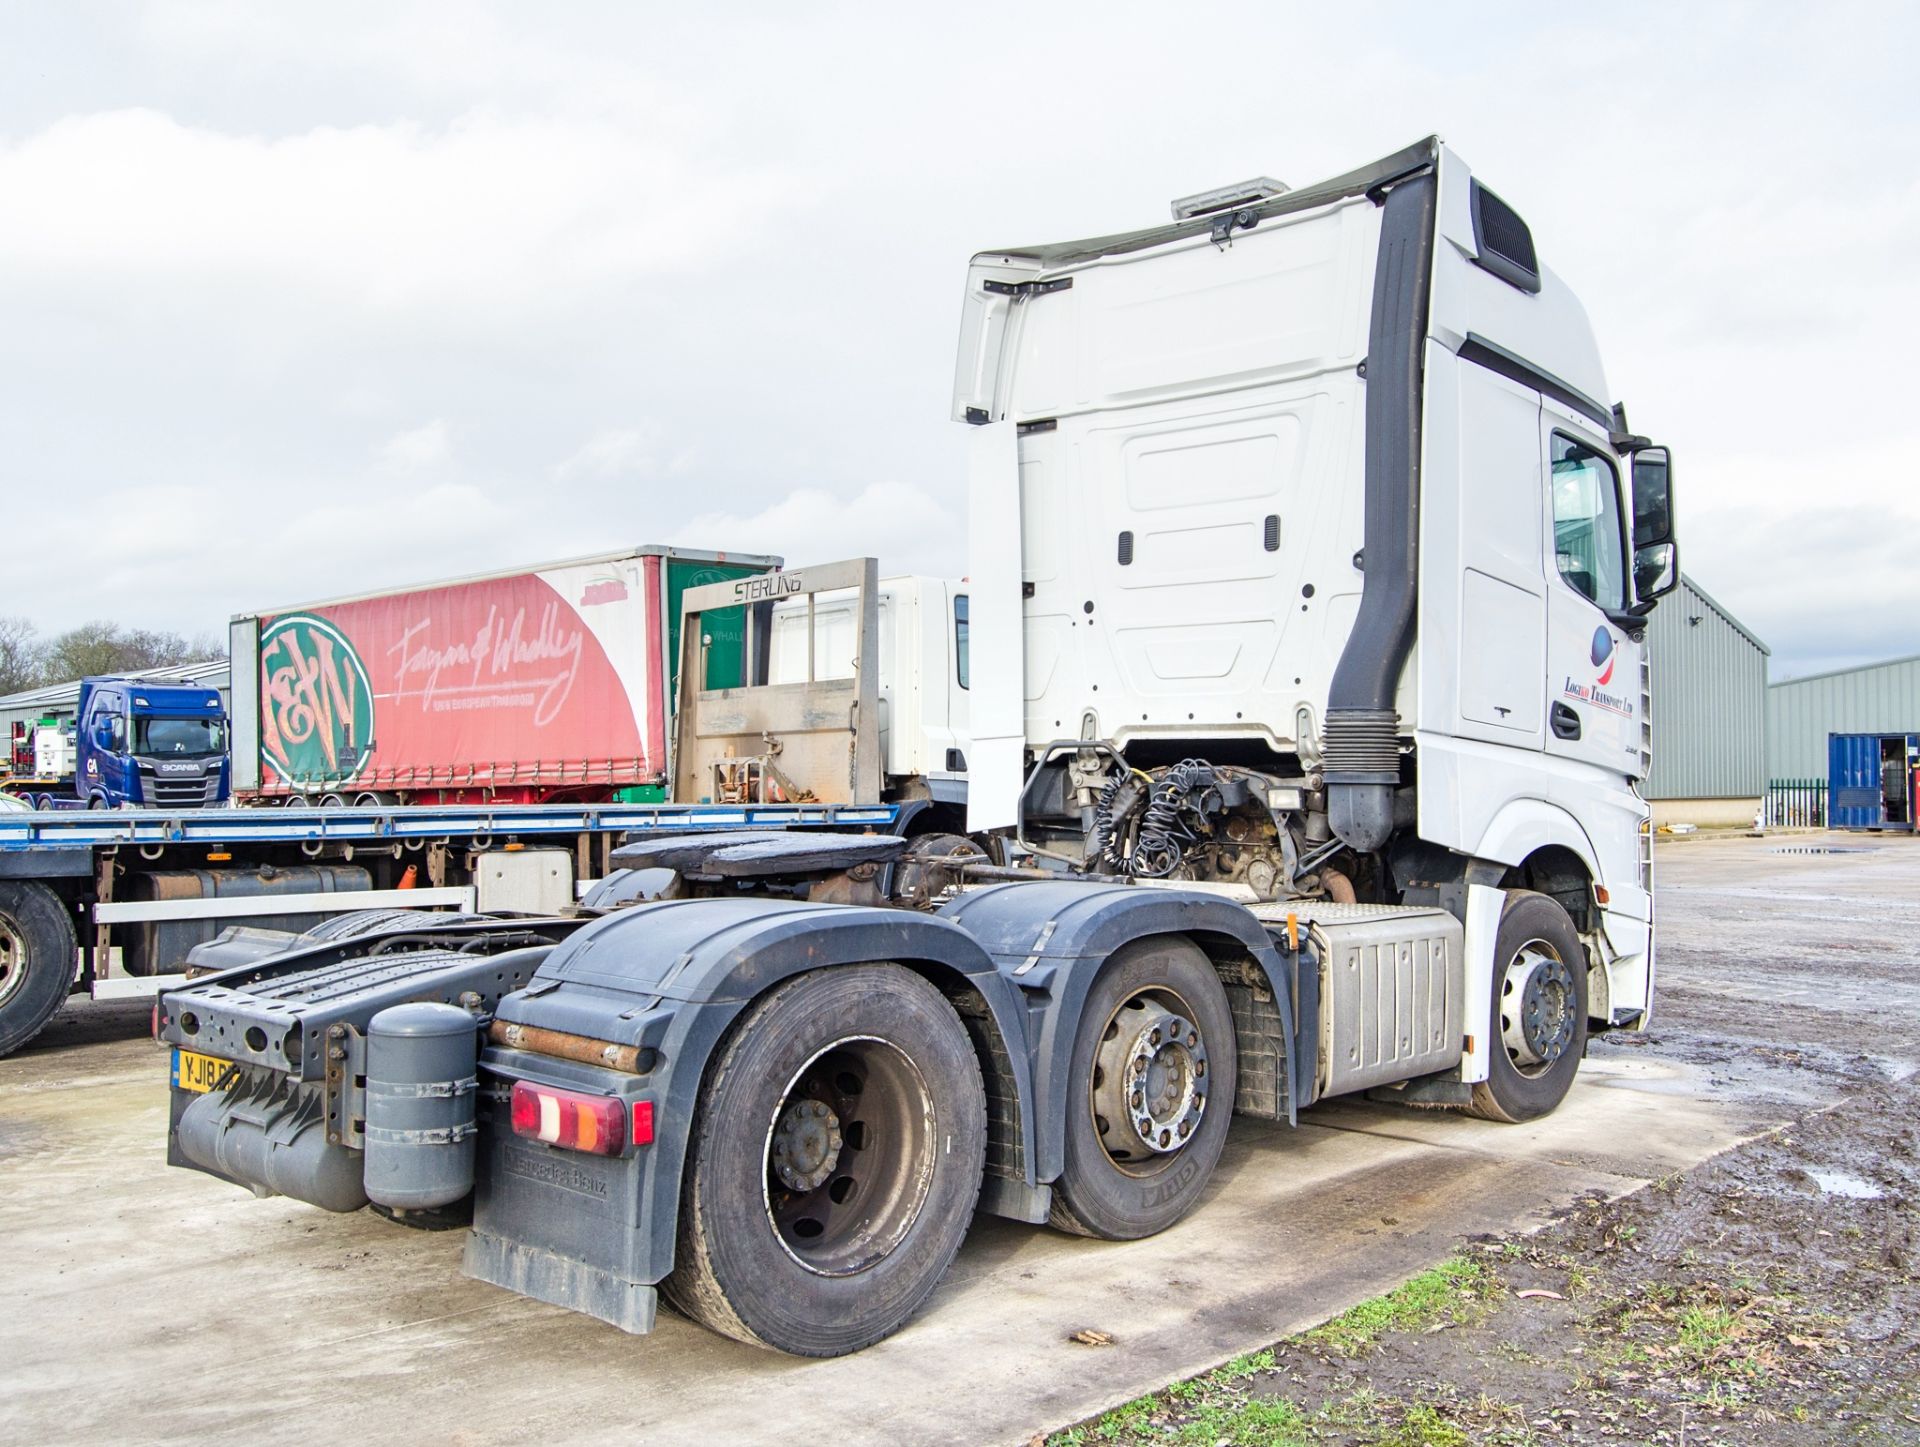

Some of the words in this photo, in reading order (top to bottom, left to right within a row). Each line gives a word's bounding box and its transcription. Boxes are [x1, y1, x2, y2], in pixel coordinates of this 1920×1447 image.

[734, 572, 803, 602] STERLING
[87, 758, 98, 774] GA
[161, 764, 200, 772] SCANIA
[186, 1055, 215, 1088] YJ18
